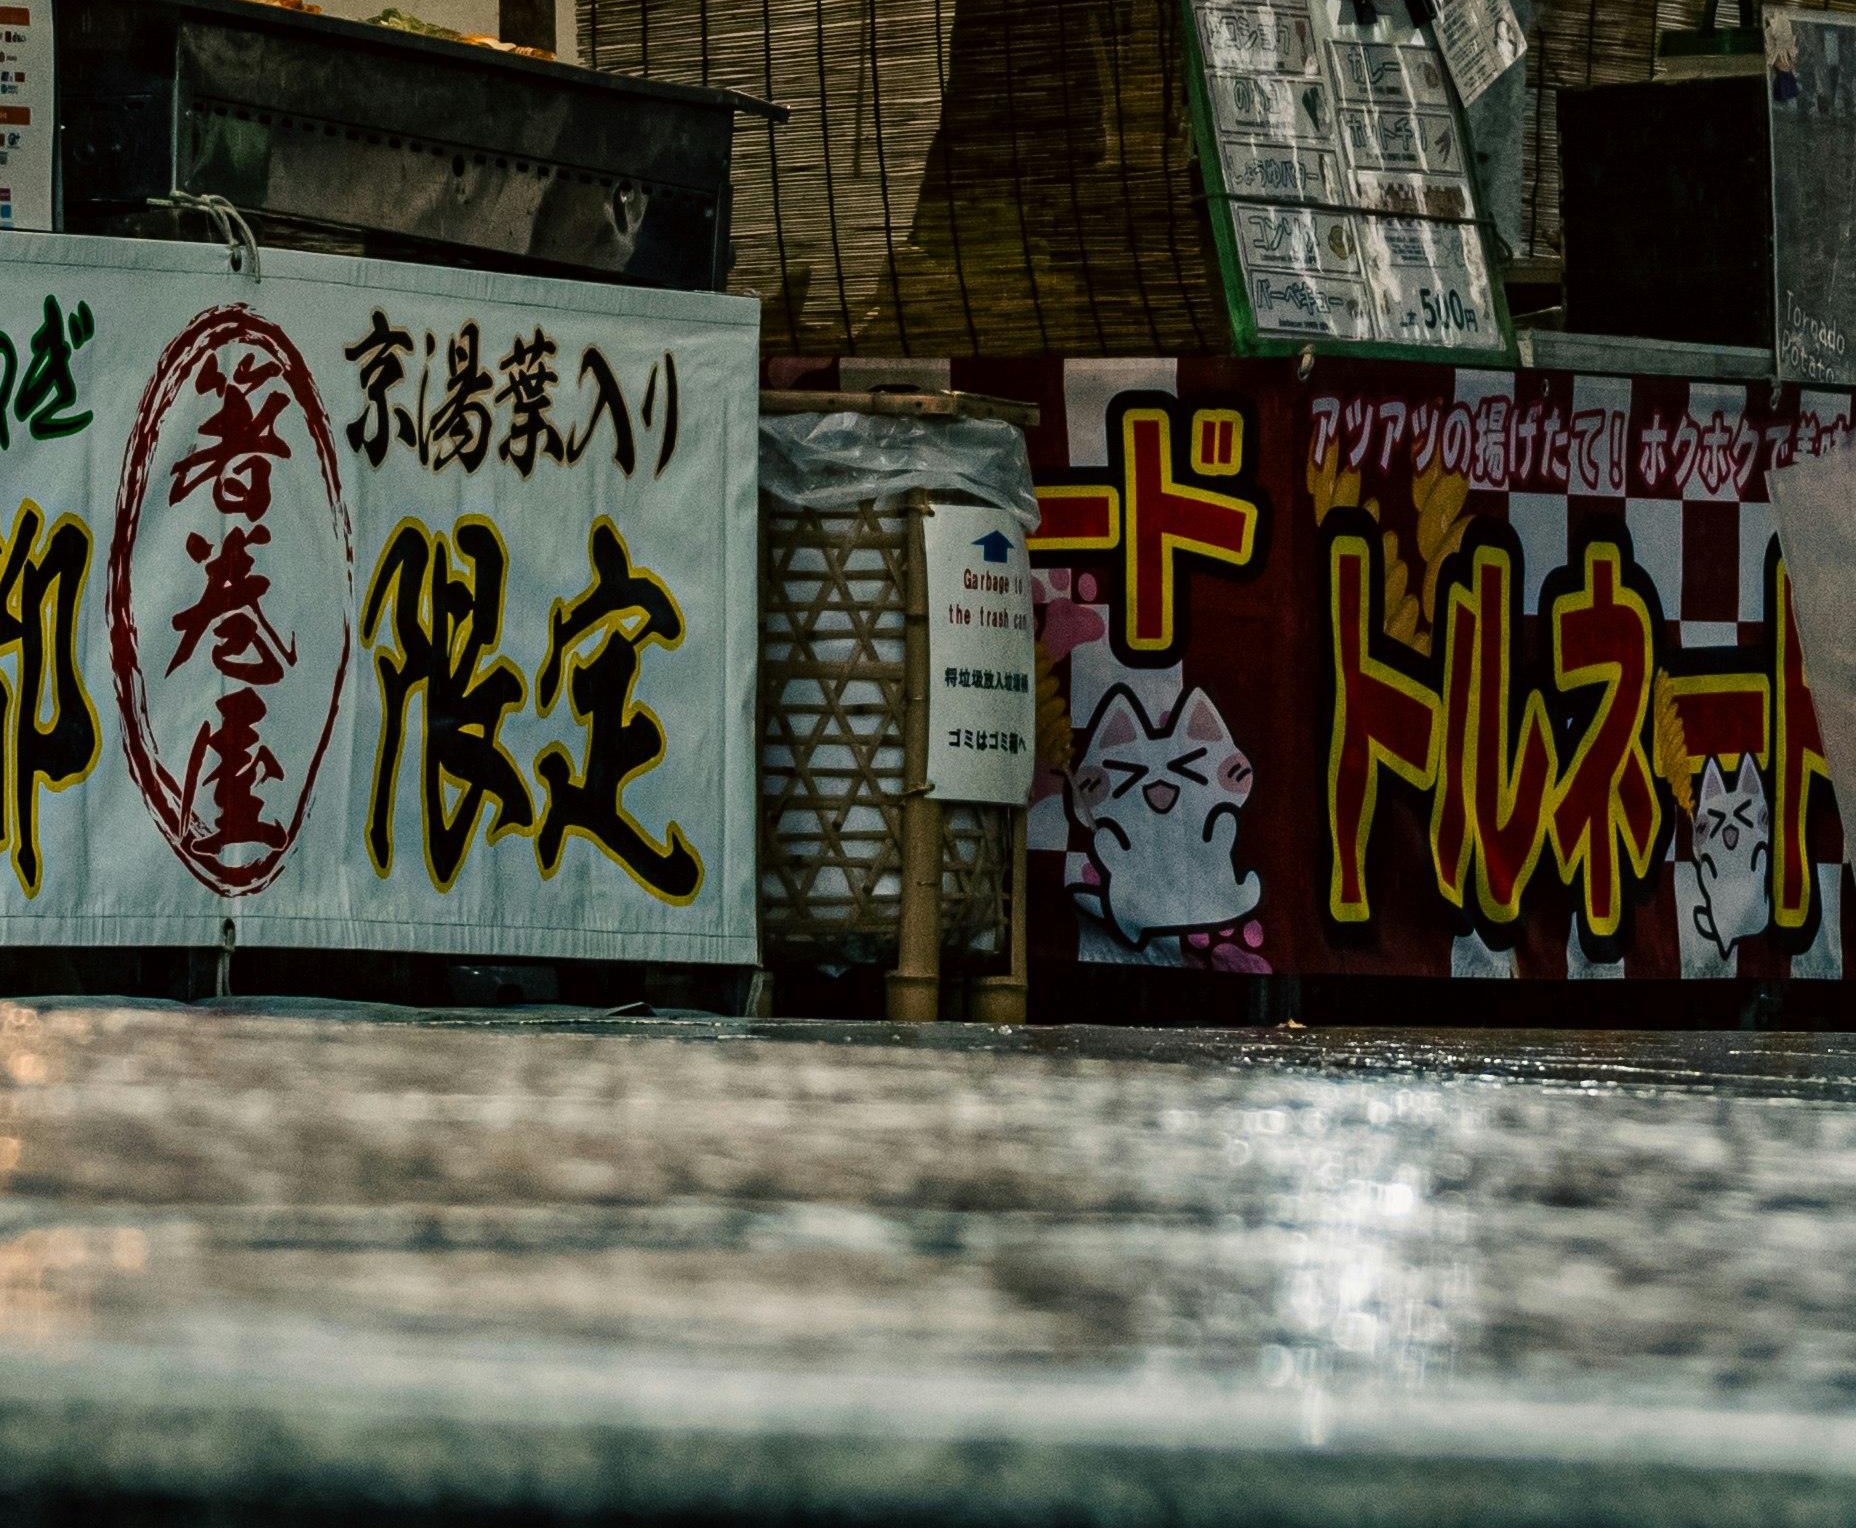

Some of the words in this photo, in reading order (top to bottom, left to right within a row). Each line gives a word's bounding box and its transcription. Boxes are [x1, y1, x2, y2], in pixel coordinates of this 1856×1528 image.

[1419, 286, 1479, 334] 500円
[1784, 289, 1846, 356] Tornado
[1780, 334, 1837, 384] Potato
[340, 309, 680, 481] 京湯葉入り
[162, 348, 298, 858] 箸巻屋
[963, 568, 1010, 594] Garbage
[948, 603, 972, 625] the
[979, 605, 1010, 629] trash
[1013, 611, 1027, 630] can
[359, 513, 706, 910] 限定
[948, 728, 1027, 754] ゴミはゴミ箱へ
